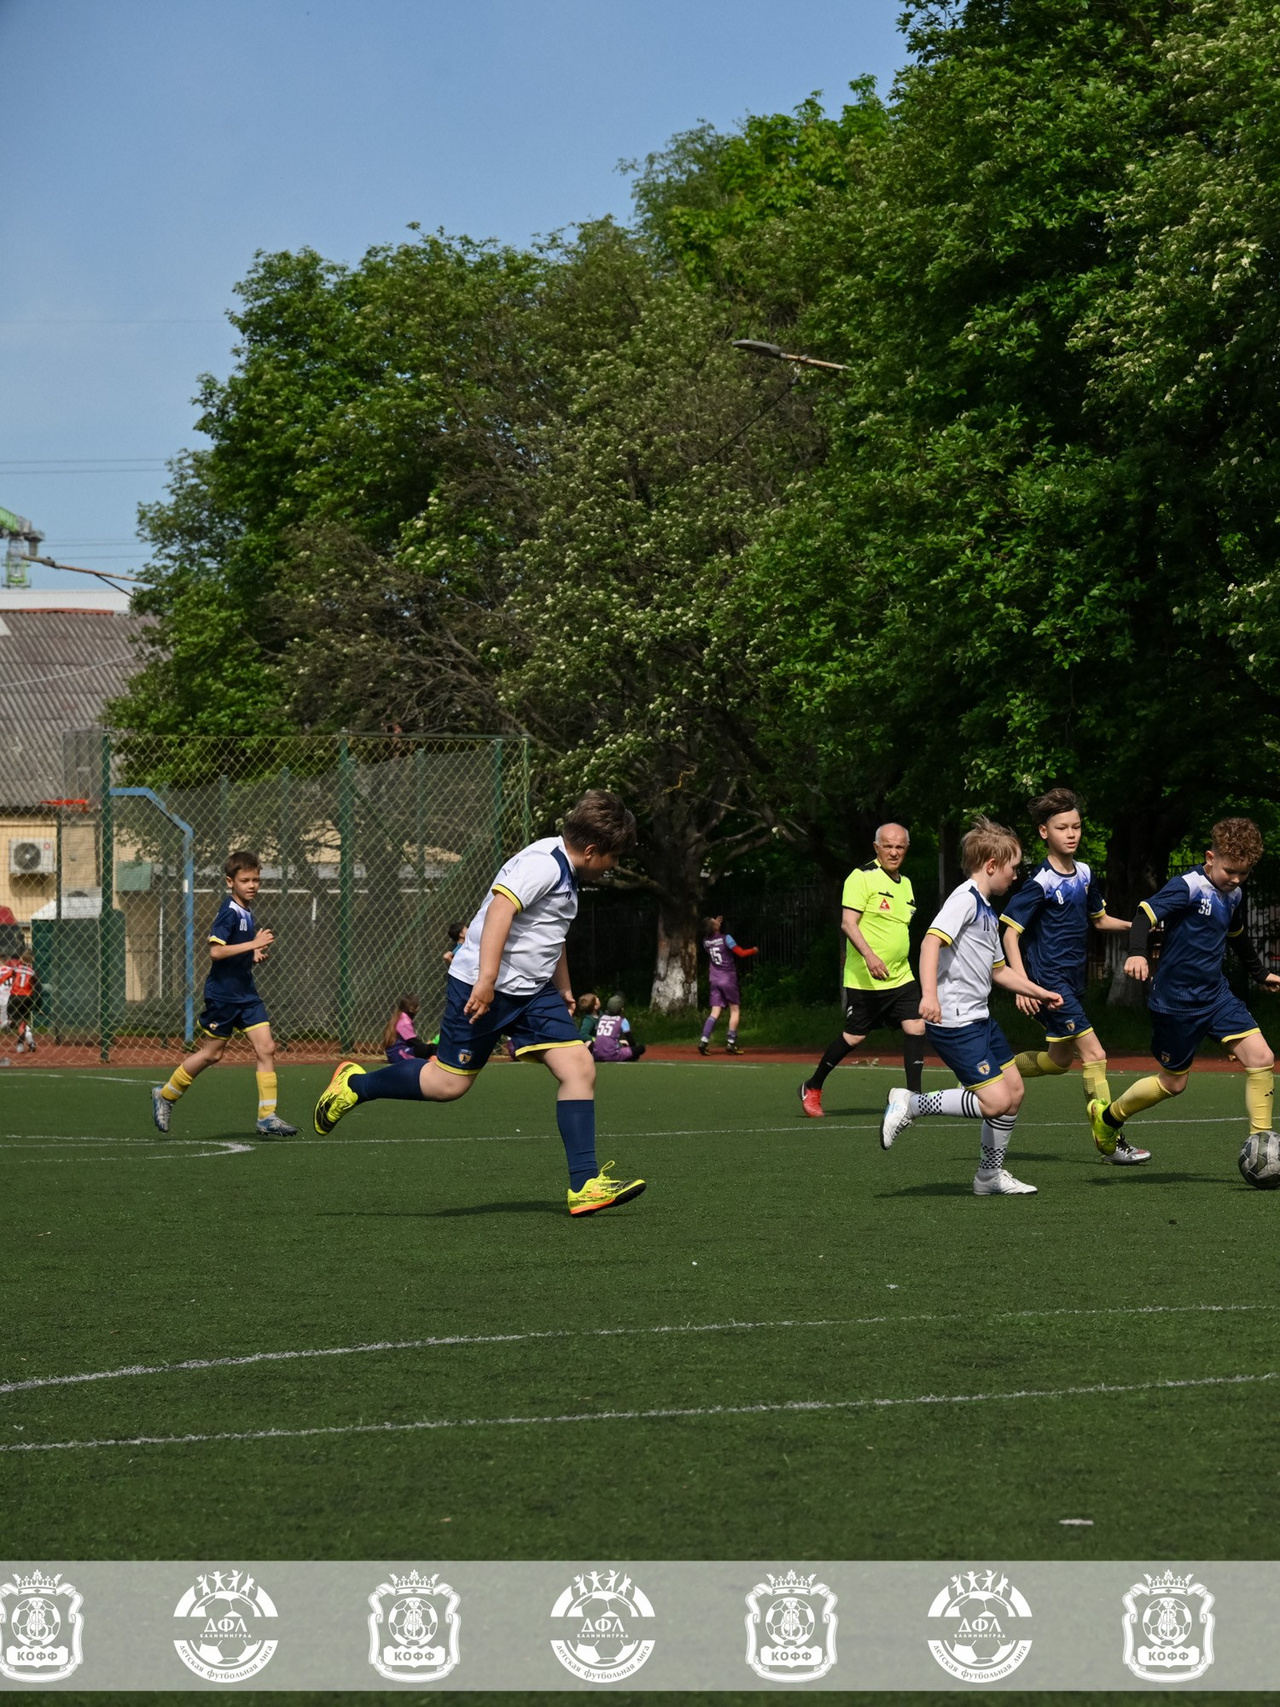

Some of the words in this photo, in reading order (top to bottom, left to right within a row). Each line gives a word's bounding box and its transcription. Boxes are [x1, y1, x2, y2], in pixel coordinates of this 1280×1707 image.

[1055, 889, 1064, 905] 8
[1198, 898, 1212, 916] 35
[596, 1020, 616, 1036] 55
